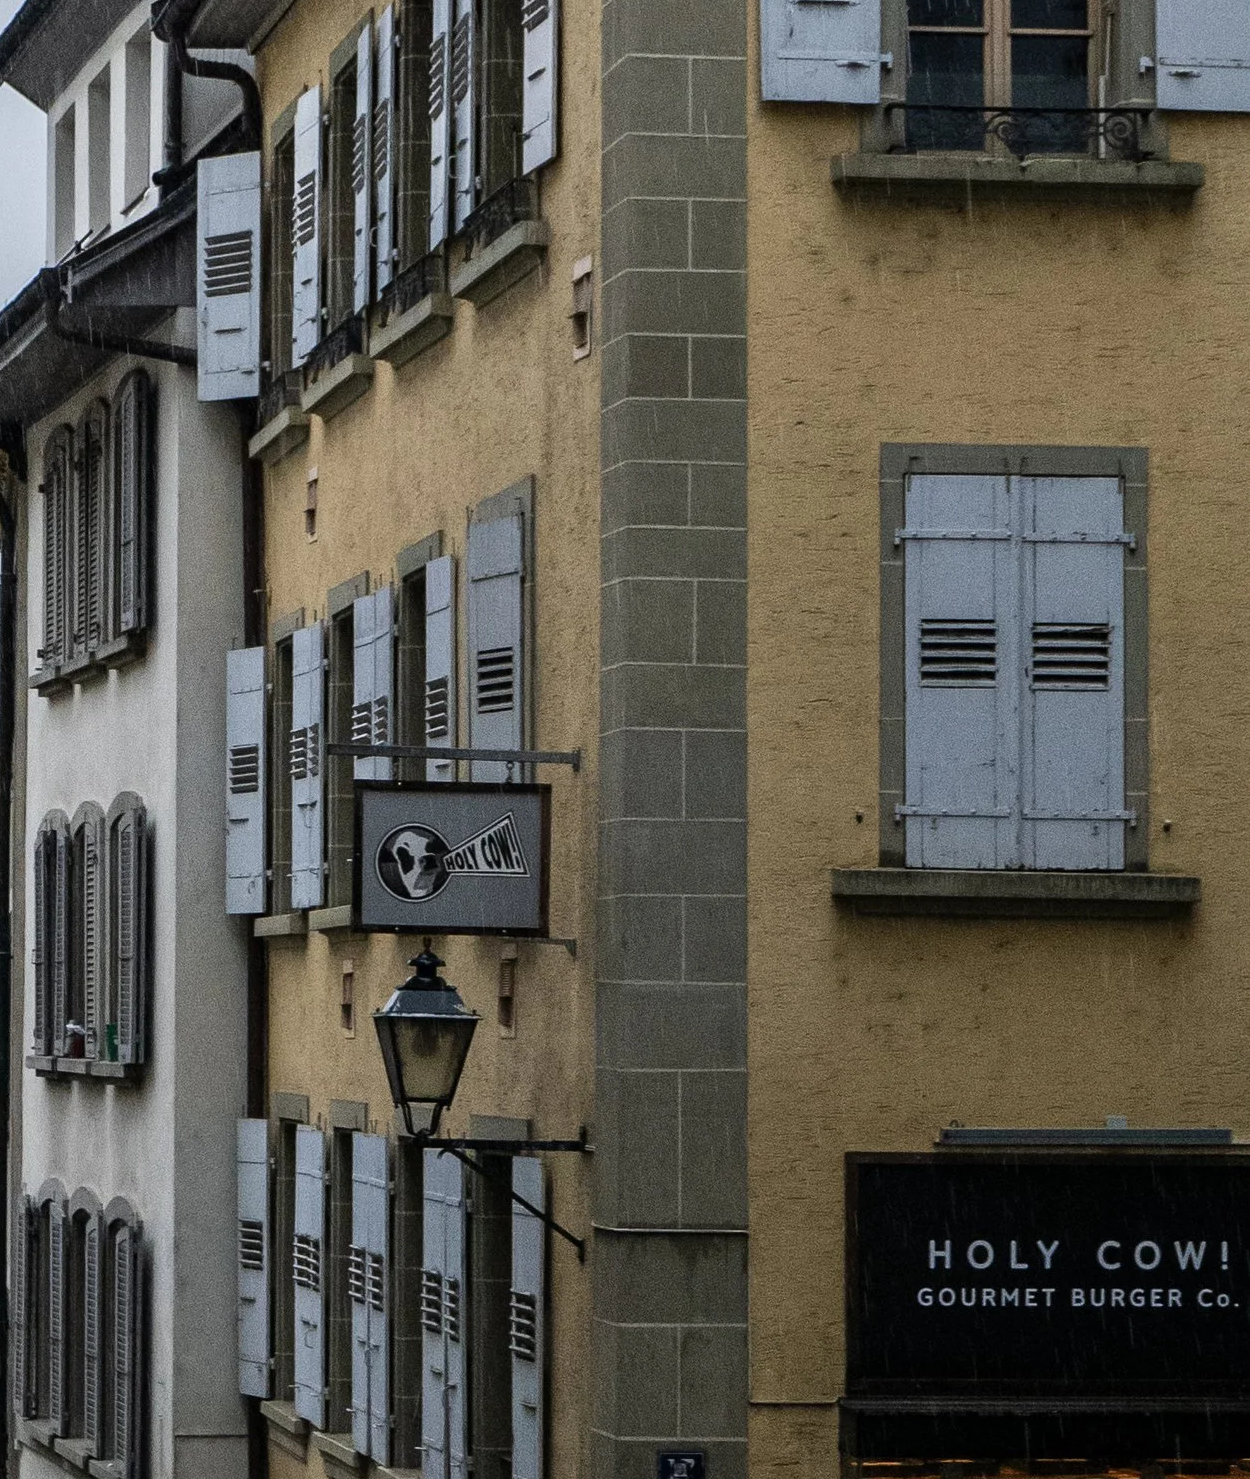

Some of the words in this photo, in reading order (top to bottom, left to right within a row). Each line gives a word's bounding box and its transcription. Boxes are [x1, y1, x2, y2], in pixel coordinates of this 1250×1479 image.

[445, 843, 480, 870] HOLY
[480, 823, 522, 870] COW!
[928, 1239, 1061, 1270] HOLY
[1096, 1239, 1230, 1271] COW!
[916, 1287, 1056, 1308] GOURMET
[1070, 1287, 1183, 1308] BURGER
[1196, 1287, 1241, 1308] Co.
